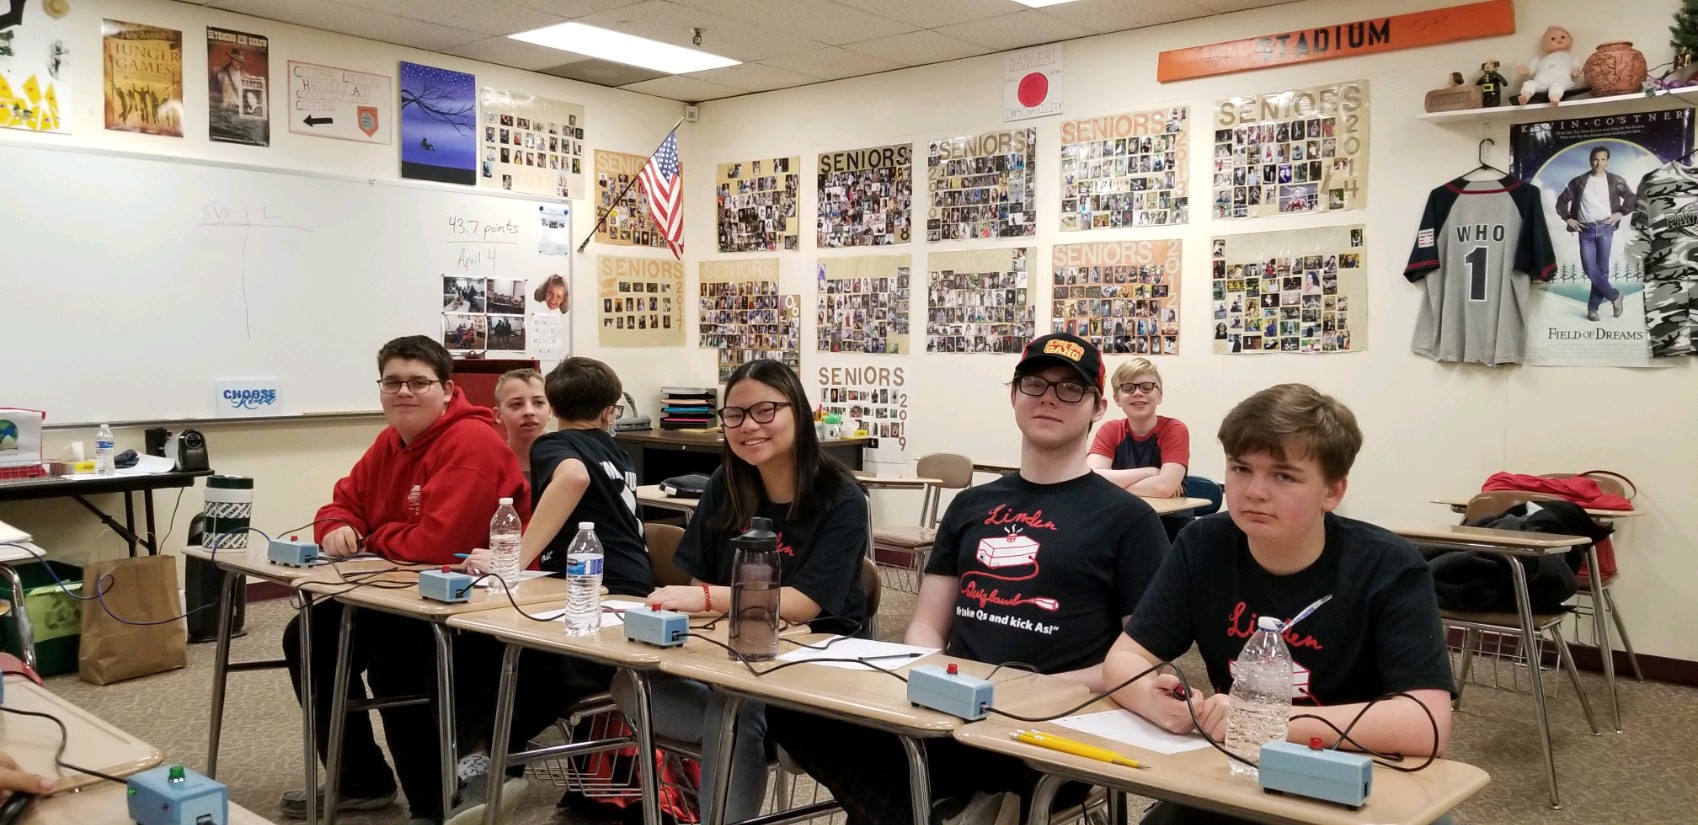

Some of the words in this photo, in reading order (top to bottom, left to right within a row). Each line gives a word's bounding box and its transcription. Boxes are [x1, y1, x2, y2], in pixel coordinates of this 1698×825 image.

[1256, 18, 1391, 61] STADIUM
[115, 57, 172, 76] GAMES
[1009, 48, 1056, 72] DANGER!
[1219, 86, 1362, 126] SENIORS
[1062, 111, 1166, 144] SENIORS
[1594, 112, 1684, 127] COSTNER
[940, 131, 1026, 160] SENIORS
[1343, 114, 1361, 198] 2014
[597, 153, 650, 174] SENIO
[821, 147, 908, 173] SENIORS
[449, 217, 479, 234] 43.7
[484, 220, 519, 240] points
[1457, 224, 1505, 242] WHO
[458, 248, 481, 270] April
[488, 248, 496, 272] 4
[1053, 242, 1152, 266] SENIORS
[602, 258, 684, 279] SENIORS
[1165, 239, 1180, 308] 2012
[1465, 246, 1489, 301] 1
[675, 281, 683, 331] 2017
[1548, 327, 1581, 340] FIELD
[1583, 330, 1595, 339] OF
[1596, 327, 1643, 340] DREAMS
[1044, 346, 1082, 361] GANG
[818, 366, 904, 386] SENIORS
[223, 389, 276, 399] CHOOSE
[899, 394, 908, 451] 2019
[984, 504, 1057, 530] Linden
[976, 609, 988, 621] Qs
[989, 615, 1009, 625] and
[1010, 616, 1033, 631] kick
[1227, 602, 1323, 650] Liden
